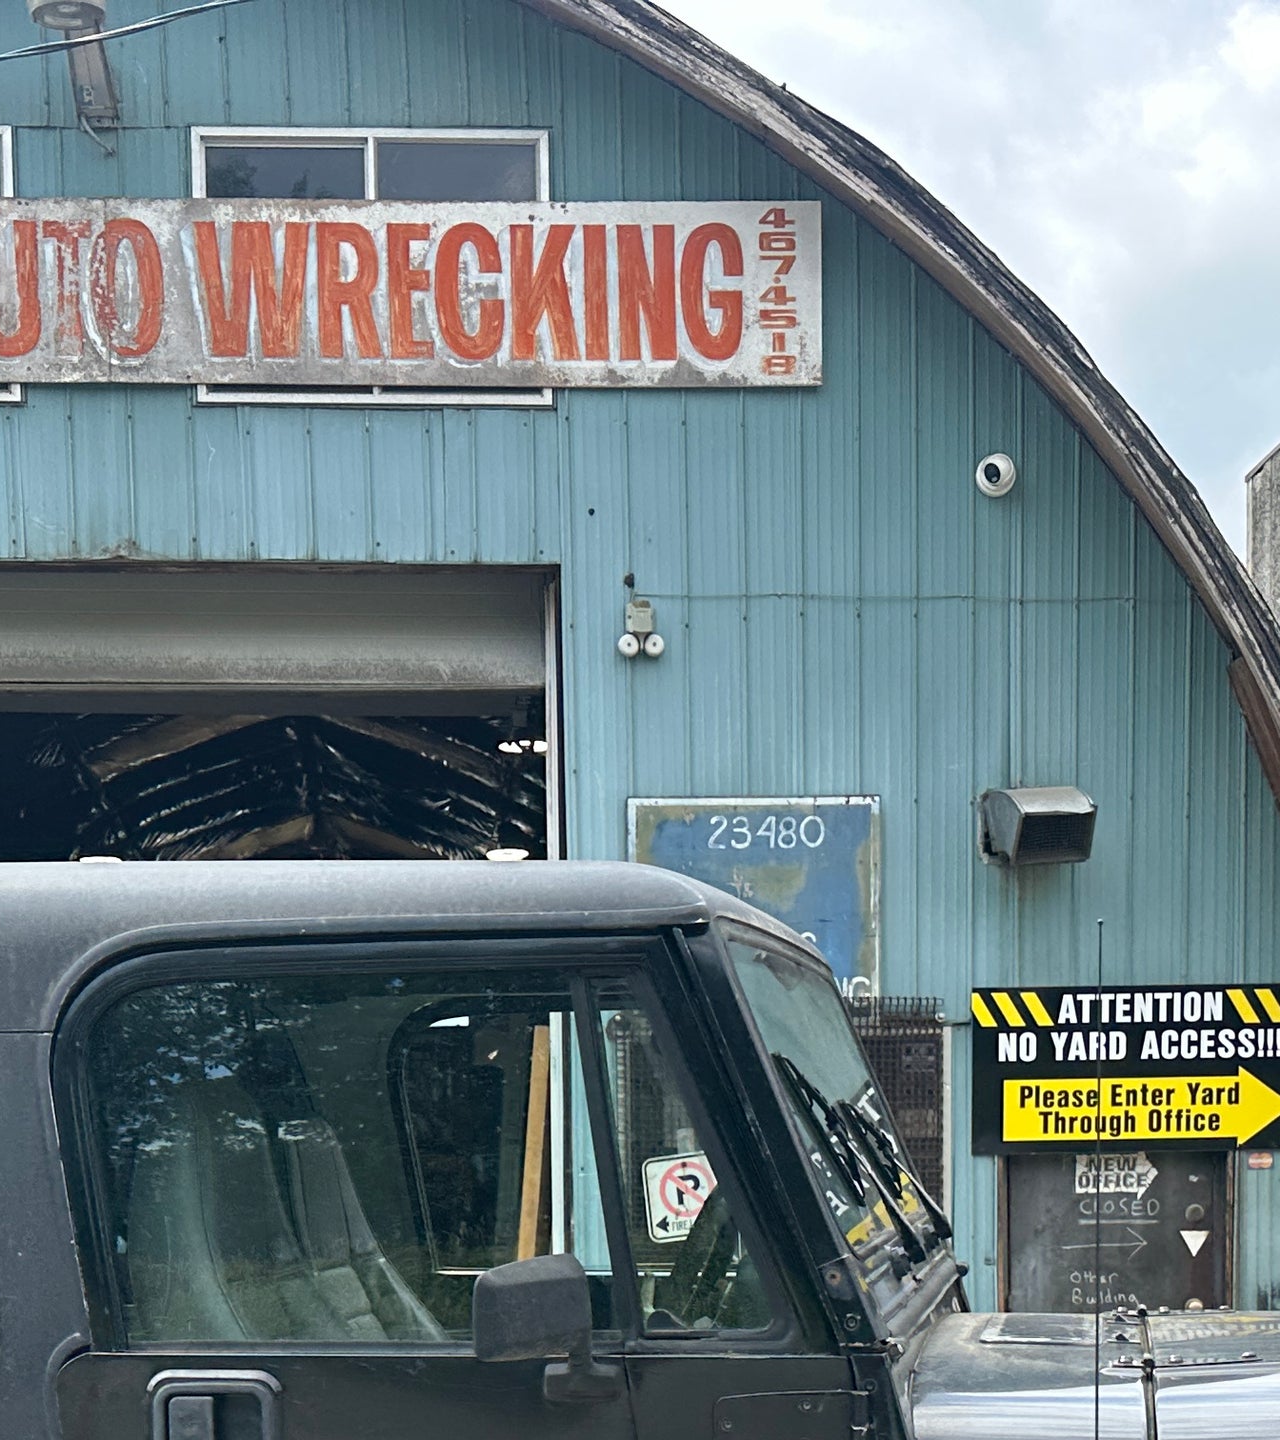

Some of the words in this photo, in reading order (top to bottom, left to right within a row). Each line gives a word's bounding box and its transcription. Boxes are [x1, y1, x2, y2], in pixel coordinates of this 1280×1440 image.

[193, 221, 744, 361] WRECKING
[708, 815, 825, 849] 23480
[1057, 991, 1223, 1024] ATTENTION
[998, 1031, 1037, 1062] NO
[1051, 1030, 1127, 1061] YARD
[1019, 1085, 1099, 1108] Please
[1111, 1083, 1175, 1107] Enter
[1187, 1082, 1240, 1106] Yard
[1039, 1111, 1136, 1136] Through
[1148, 1109, 1221, 1133] Office
[1087, 1155, 1138, 1172] NEW
[1078, 1172, 1150, 1189] OFFICE
[1080, 1198, 1160, 1216] CLOSED
[1071, 1287, 1139, 1306] Bulding
